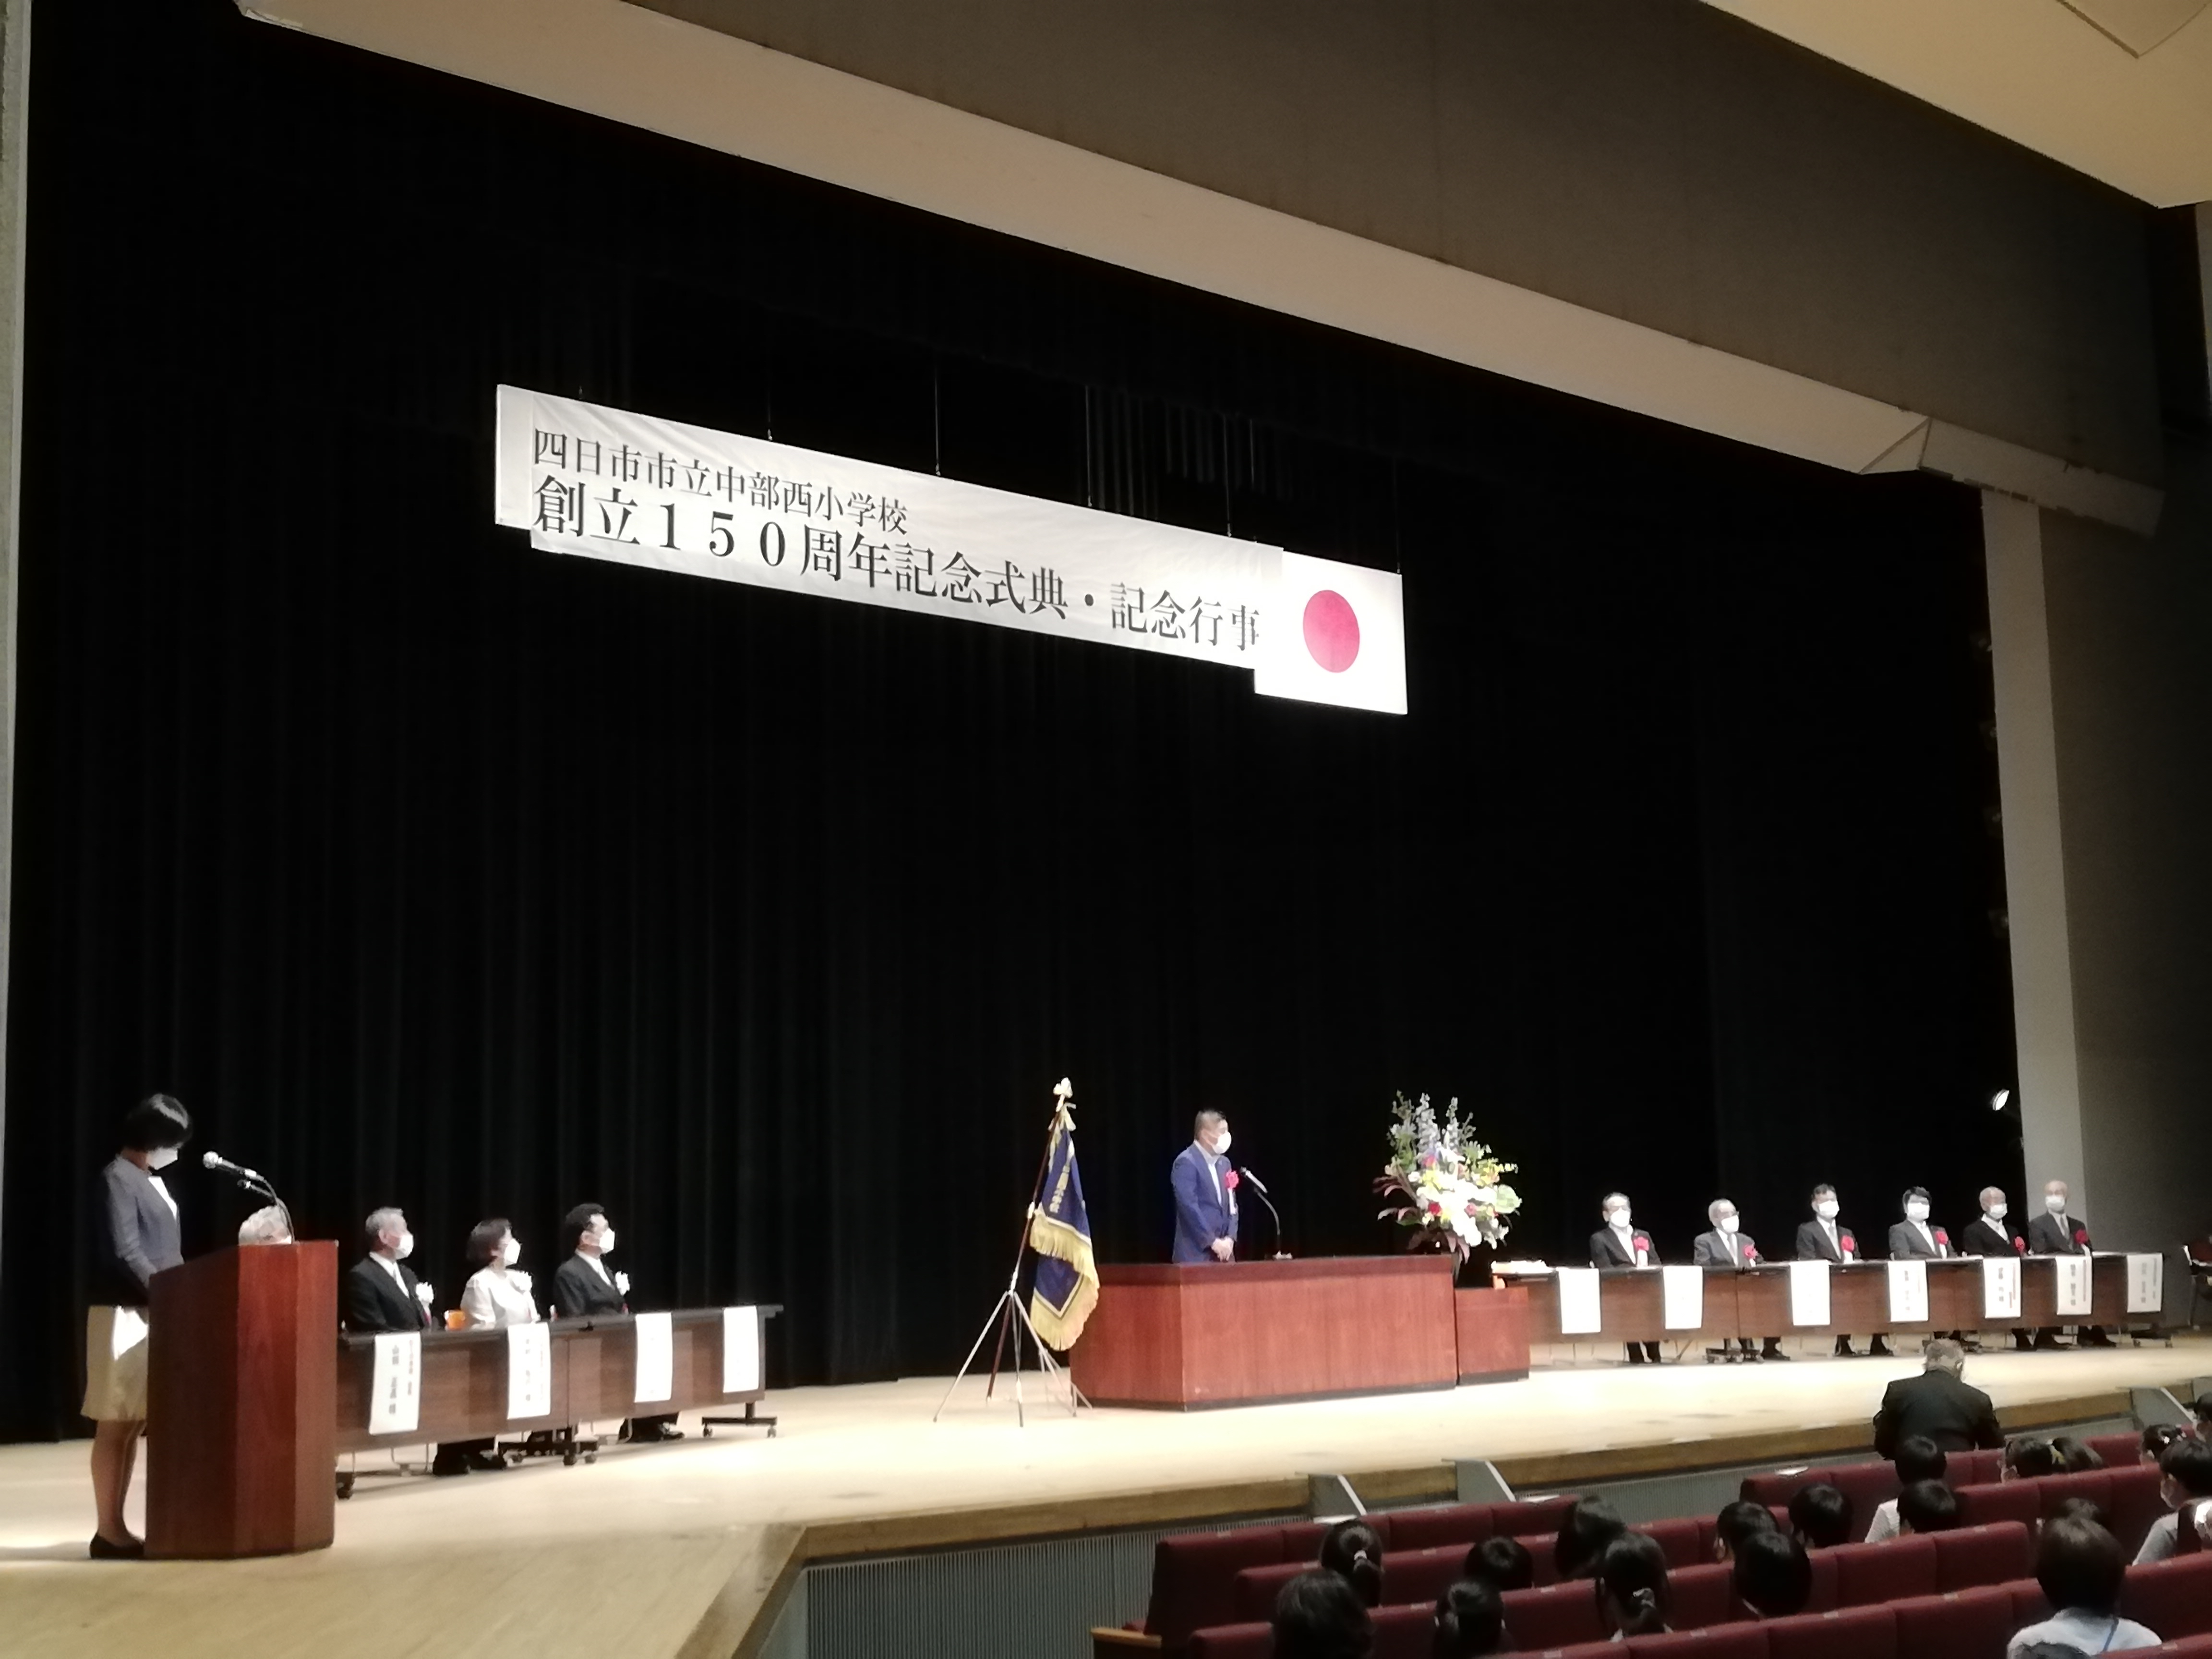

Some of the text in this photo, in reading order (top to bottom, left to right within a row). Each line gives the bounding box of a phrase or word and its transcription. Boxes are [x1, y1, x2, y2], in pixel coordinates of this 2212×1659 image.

[534, 427, 908, 536] 四日市市立中部西小学校
[532, 474, 1261, 652] 創立150周年記念式典・記念行事
